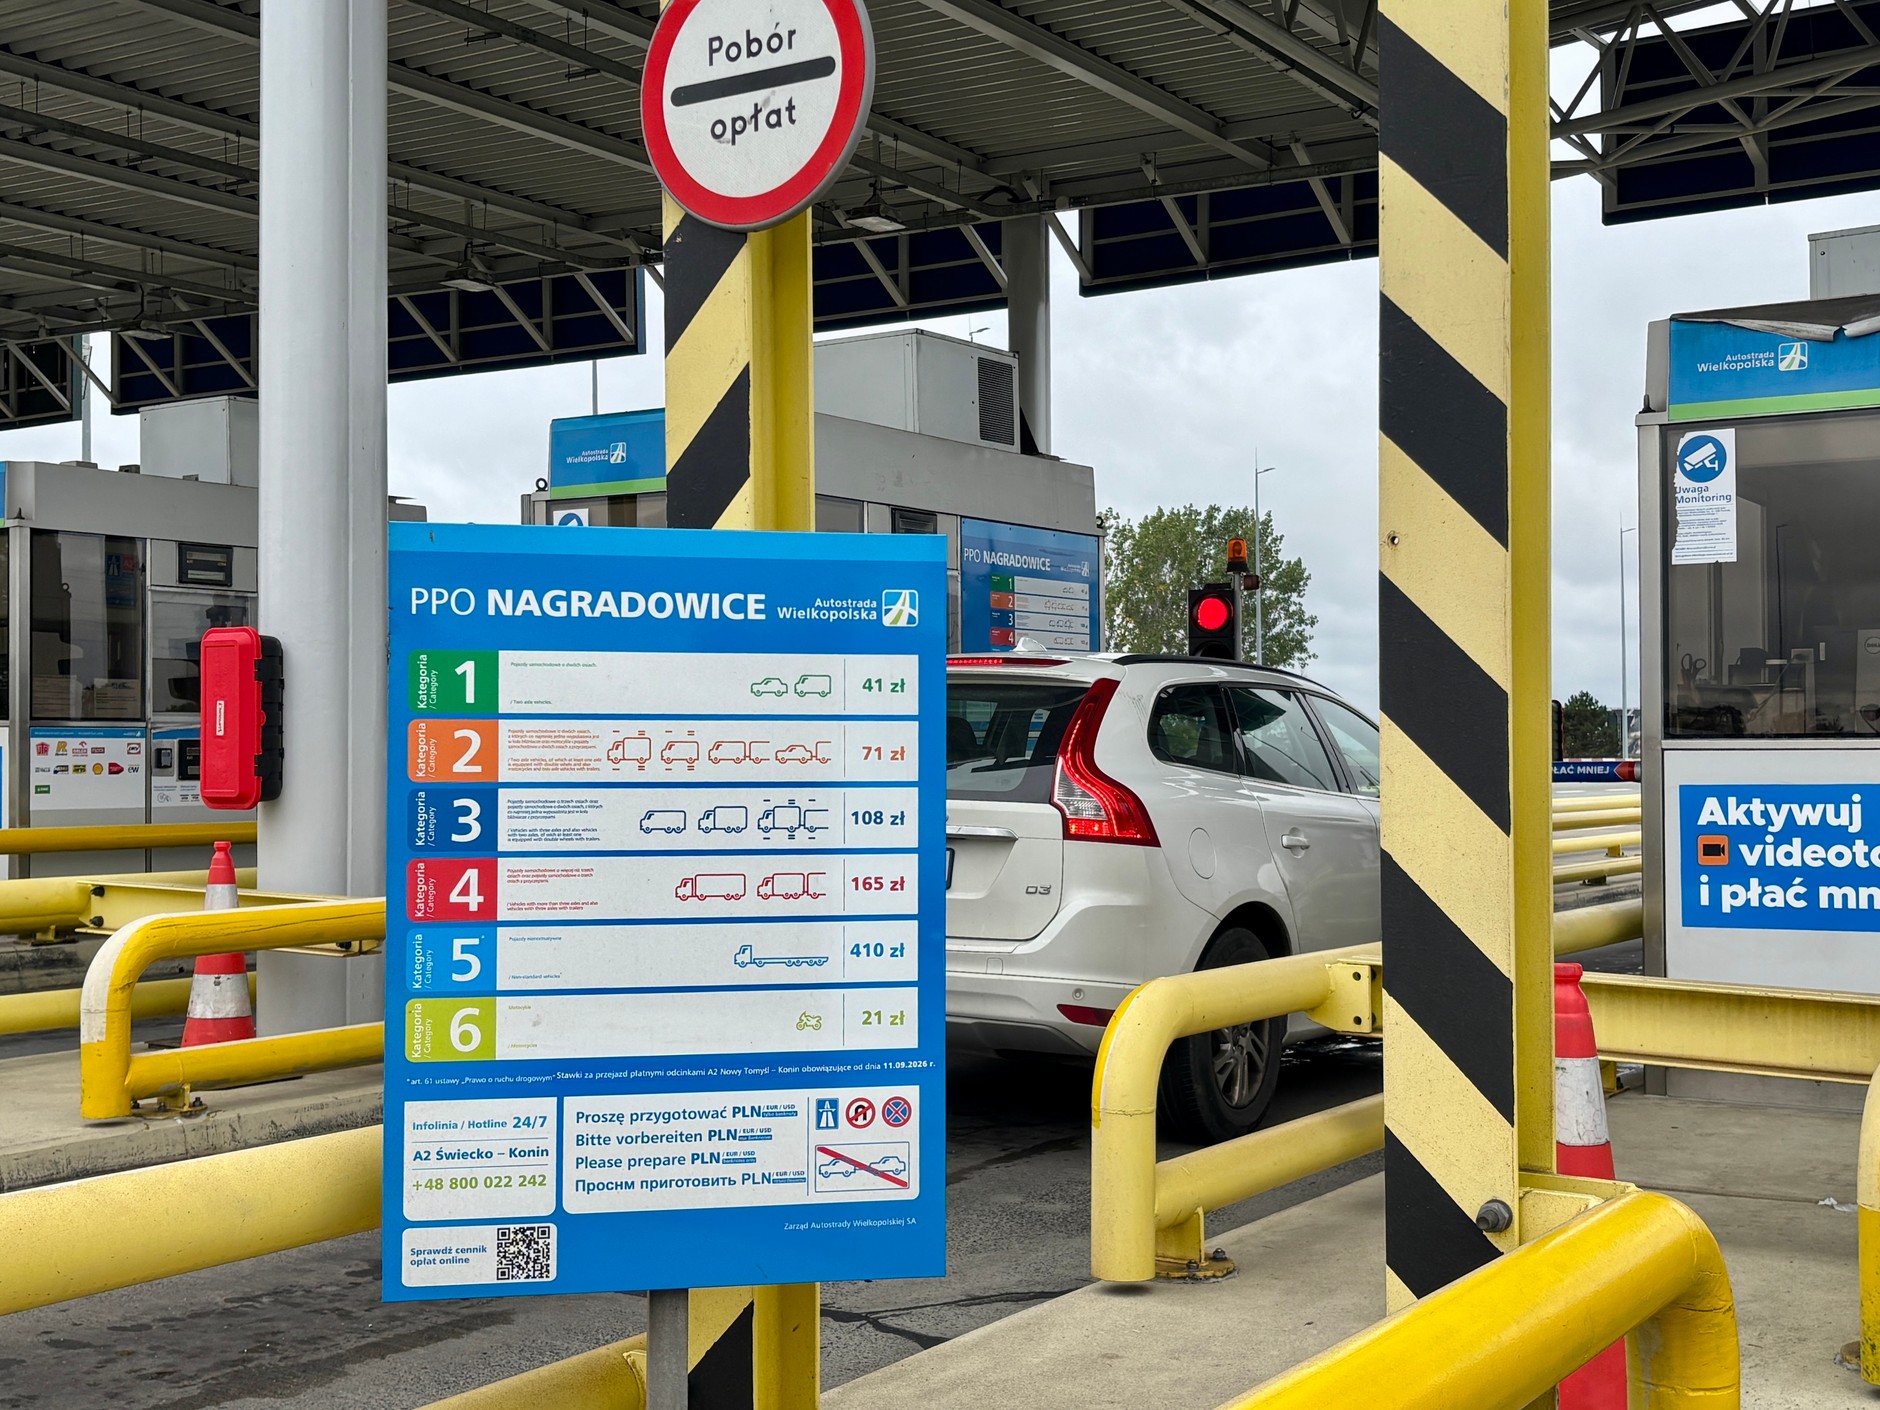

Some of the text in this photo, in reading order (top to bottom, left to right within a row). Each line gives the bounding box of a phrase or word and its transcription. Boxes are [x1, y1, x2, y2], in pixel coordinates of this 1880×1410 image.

[708, 22, 796, 66] Pobór
[710, 96, 797, 146] opłat
[1725, 351, 1774, 361] Autostrada
[1697, 359, 1774, 373] Wielkopolska
[566, 454, 608, 464] Wielkopolska
[582, 449, 608, 457] Autostrada
[1676, 493, 1731, 503] Monitoring
[964, 547, 981, 563] PPO
[983, 551, 1051, 571] NAGRADOWICE
[1008, 578, 1013, 590] 1
[411, 587, 766, 620] PPO NAGRADOWICE
[814, 597, 877, 608] Autostrada
[1008, 595, 1013, 608] 2
[777, 607, 877, 622] Wielkopolska
[1008, 614, 1013, 626] 3
[1008, 631, 1013, 643] 4
[417, 654, 430, 708] Kategoria
[430, 669, 438, 706] Category
[454, 660, 475, 704] 1
[861, 678, 906, 693] 41 zł
[416, 723, 428, 777] Kategoria
[428, 738, 437, 772] Category
[452, 729, 482, 772] 2
[861, 746, 906, 761] 71 zł
[1552, 764, 1610, 775] ŁAĆ MNIEJ
[415, 791, 428, 846] Kategoria
[451, 798, 482, 843] 3
[851, 810, 906, 826] 108 zł
[1697, 793, 1862, 833] Aktywuj
[428, 806, 437, 841] Category
[415, 863, 427, 917] Kategoria
[449, 868, 484, 912] 4
[851, 876, 905, 891] 165 zł
[1025, 884, 1051, 895] D3
[427, 878, 436, 913] Category
[1700, 874, 1709, 906] i
[1721, 877, 1808, 913] płać
[850, 942, 905, 957] 410 zł
[412, 934, 425, 989] Kategoria
[424, 949, 434, 984] Category
[861, 1010, 905, 1025] 21 zł
[411, 1003, 424, 1058] Kategoria
[423, 1018, 433, 1053] Category
[450, 1007, 482, 1053] 6
[435, 1078, 459, 1086] ustawy
[556, 1071, 583, 1079] Stawki
[595, 1070, 628, 1080] przejazd
[666, 1068, 706, 1077] odcinkami
[720, 1068, 742, 1077] Nowy
[743, 1066, 770, 1076] Tomyśl
[801, 1064, 852, 1073] obowiązujące
[865, 1062, 881, 1070] dnia
[883, 1060, 928, 1069] 11.09.2026
[412, 1121, 458, 1131] Infolinia
[468, 1119, 508, 1129] Hotline
[512, 1115, 548, 1129] 24/7
[576, 1111, 625, 1126] Proszę
[629, 1106, 727, 1126] przygotować
[732, 1106, 761, 1118] PLN
[576, 1134, 611, 1146] Bitte
[616, 1130, 702, 1145] vorbereiten
[708, 1129, 737, 1141] PLN
[413, 1150, 431, 1162] A2
[436, 1147, 493, 1161] Świecko
[509, 1146, 549, 1159] Konin
[576, 1156, 623, 1169] Please
[628, 1156, 686, 1170] prepare
[691, 1152, 720, 1164] PLN
[412, 1174, 547, 1191] +48 800 022 242
[640, 1176, 736, 1191] приготовить
[742, 1172, 771, 1185] PLN
[784, 1217, 916, 1231] Zarząd Autostrady Wielkopolskiej SA
[410, 1245, 487, 1257] Sprawdź cennik
[410, 1256, 470, 1267] opłat online
